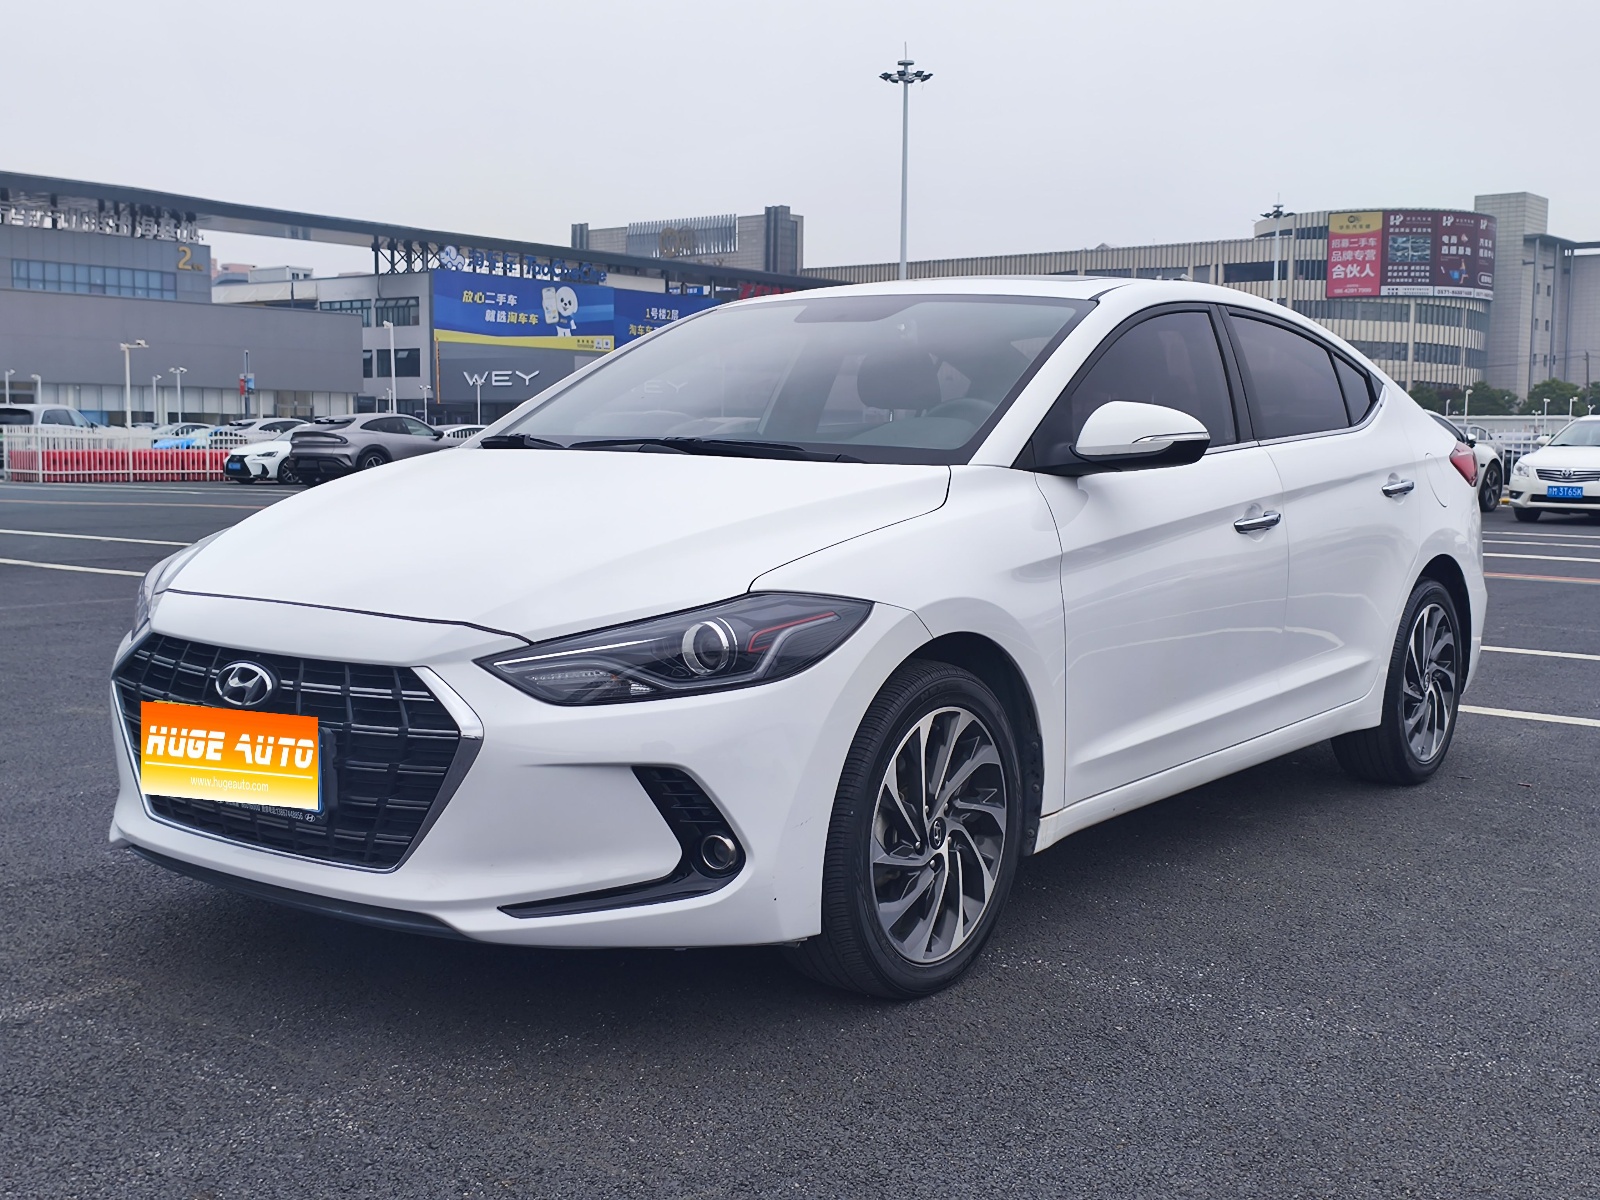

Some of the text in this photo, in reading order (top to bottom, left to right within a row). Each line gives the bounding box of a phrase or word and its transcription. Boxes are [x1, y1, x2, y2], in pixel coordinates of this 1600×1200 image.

[1331, 238, 1377, 248] 招募二手车
[1331, 249, 1376, 262] 品牌专营
[1331, 263, 1375, 279] 合伙人
[462, 290, 518, 306] 放心二手车
[485, 309, 539, 325] 就选淘车车
[463, 370, 540, 387] WEY
